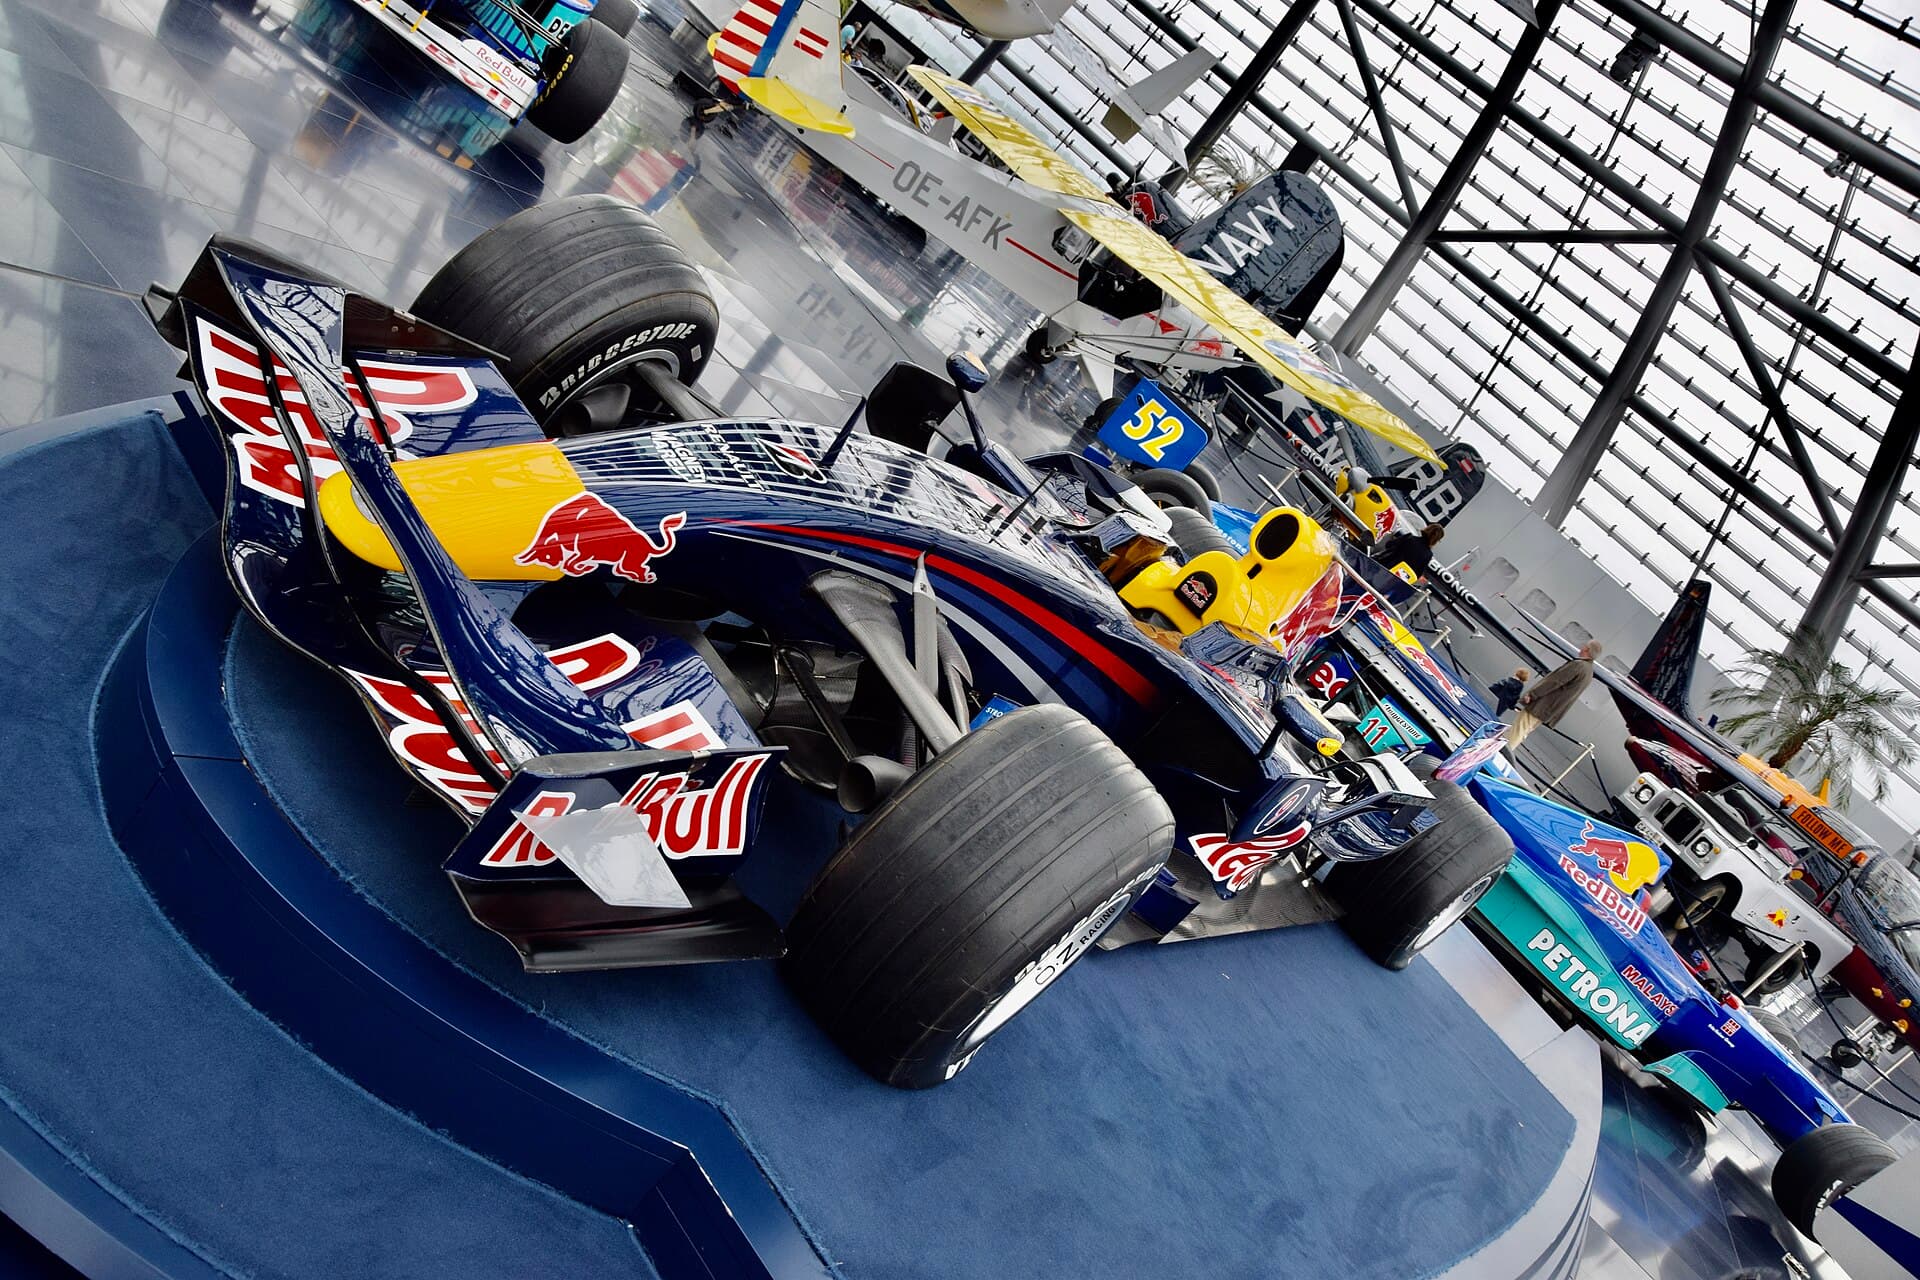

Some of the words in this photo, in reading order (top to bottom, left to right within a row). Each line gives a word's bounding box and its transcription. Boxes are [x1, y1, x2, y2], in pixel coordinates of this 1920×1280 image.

[476, 47, 501, 71] Red
[500, 66, 528, 89] Bull
[892, 160, 1013, 251] OE-AFK
[1193, 195, 1295, 276] NAVY
[700, 423, 767, 493] RENAULT
[1121, 398, 1185, 462] 52
[1396, 459, 1463, 523] RB
[1428, 557, 1475, 606] BIONIC
[1361, 718, 1389, 746] 11
[1797, 810, 1833, 841] FOLLOW
[1828, 837, 1848, 853] ME
[1079, 906, 1116, 946] RACING
[1559, 854, 1606, 899] Red
[1600, 887, 1646, 934] Bull
[1527, 928, 1652, 1046] PETRONA
